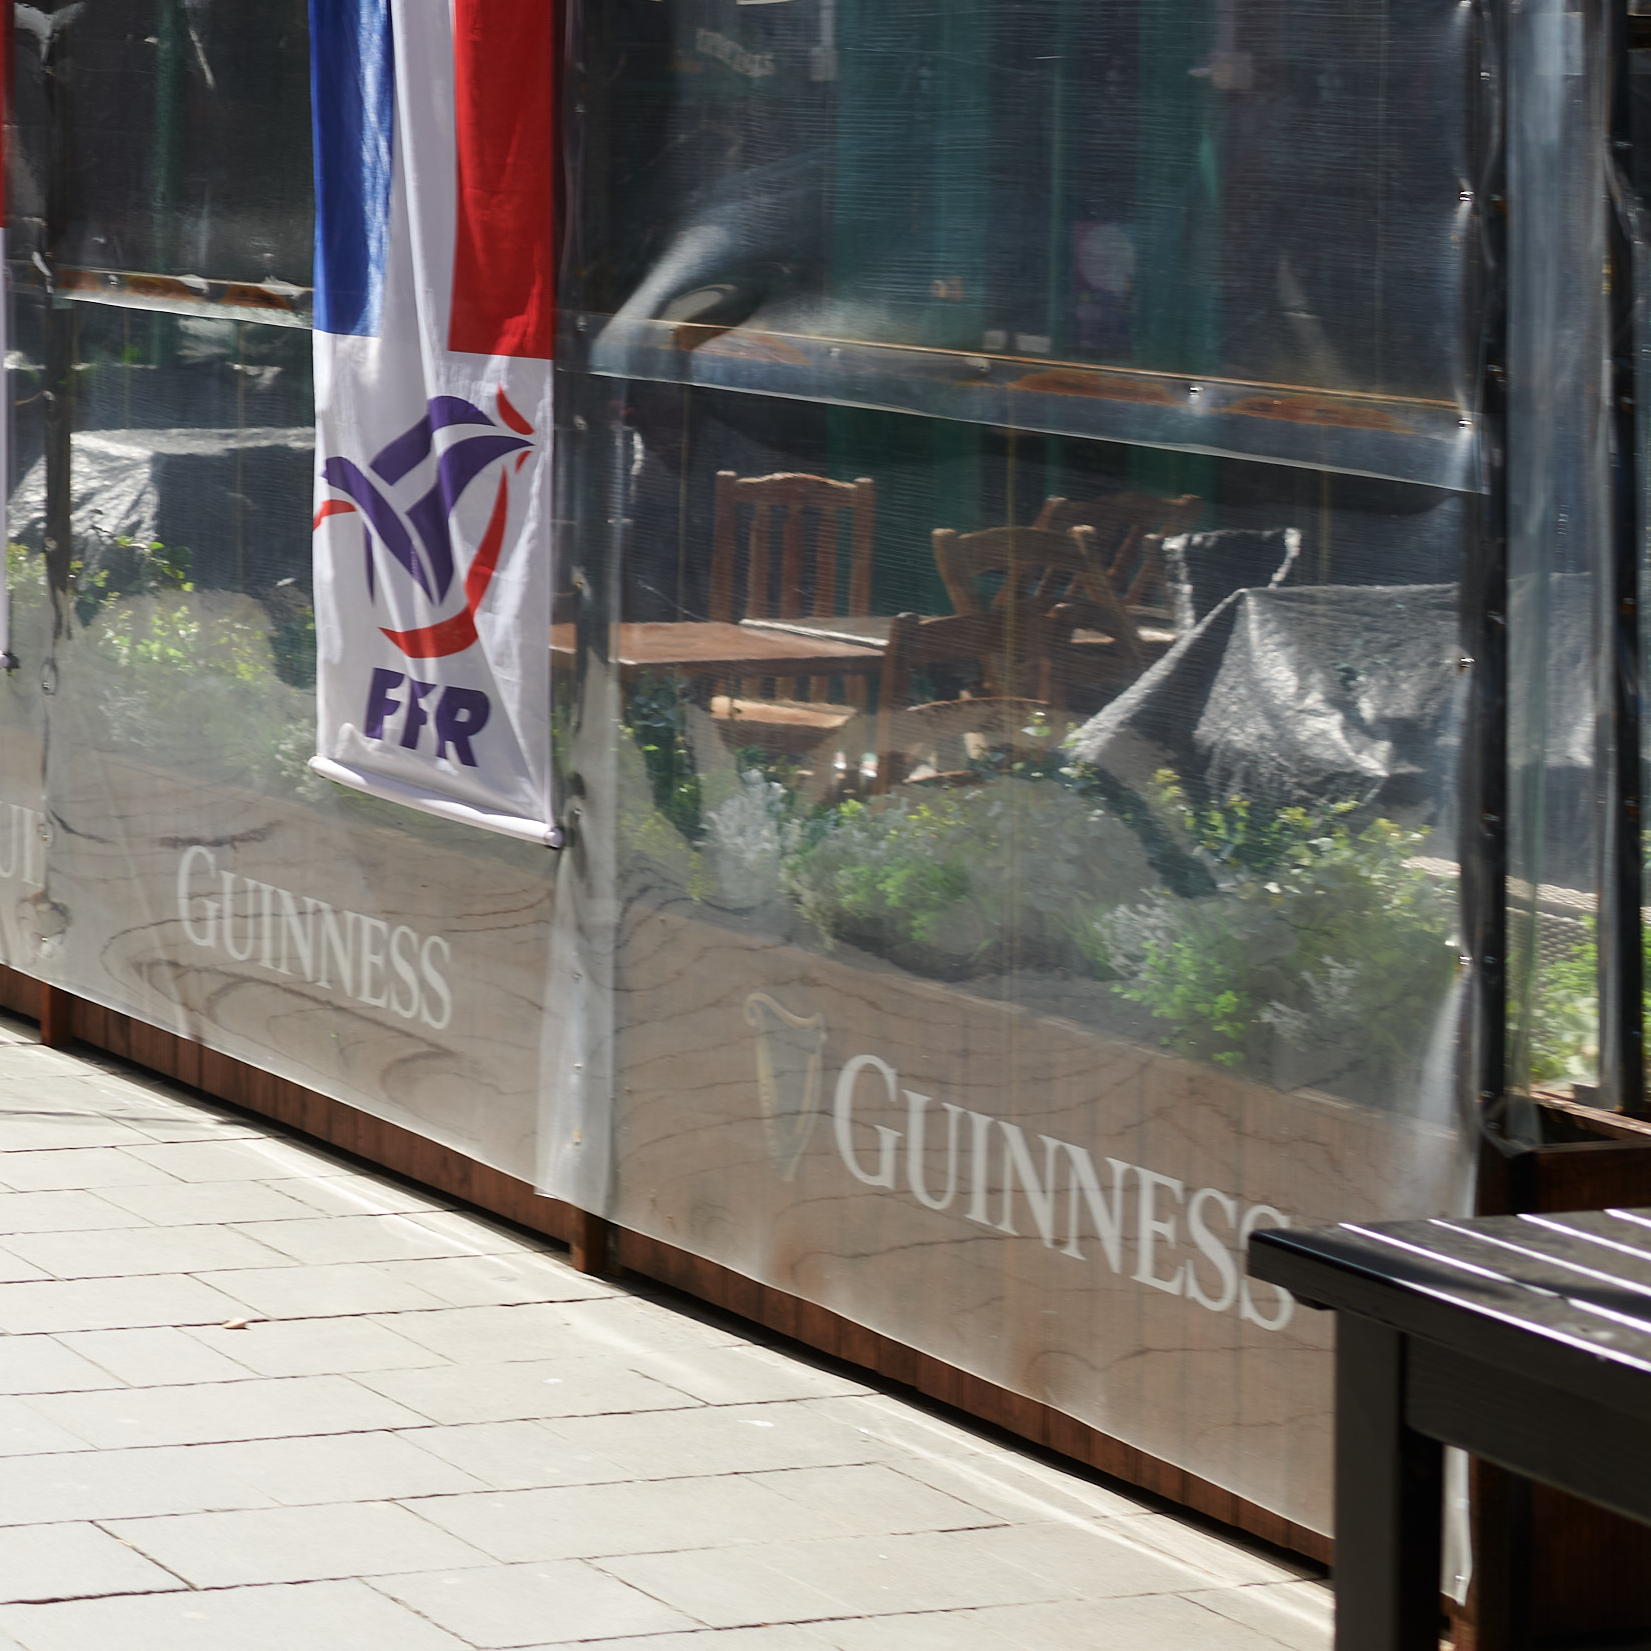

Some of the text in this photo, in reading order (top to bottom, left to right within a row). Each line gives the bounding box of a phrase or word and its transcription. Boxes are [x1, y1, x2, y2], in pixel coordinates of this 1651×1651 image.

[364, 667, 492, 768] FFR
[176, 844, 454, 1031] GUINNESS
[833, 1053, 1295, 1333] GUINNESS
